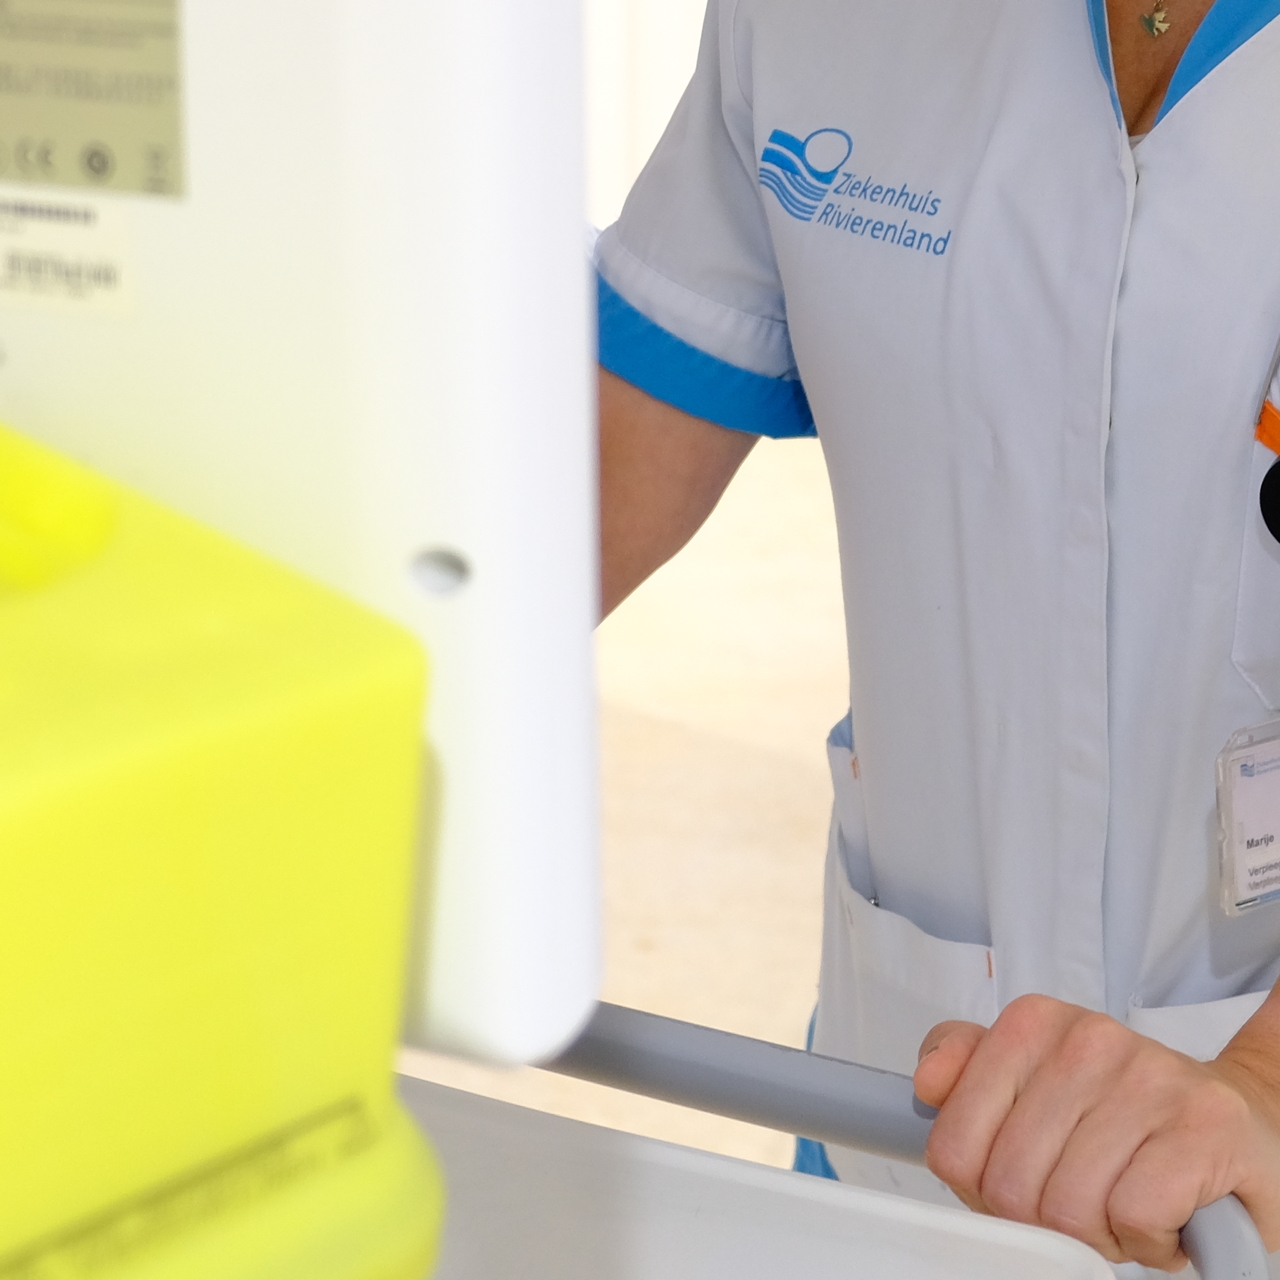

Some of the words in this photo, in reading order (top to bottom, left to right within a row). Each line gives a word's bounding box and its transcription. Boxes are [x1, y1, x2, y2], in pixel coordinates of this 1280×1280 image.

[832, 172, 941, 216] Ziekenhuis
[816, 202, 952, 256] Rivierenland
[1246, 834, 1275, 850] Marije
